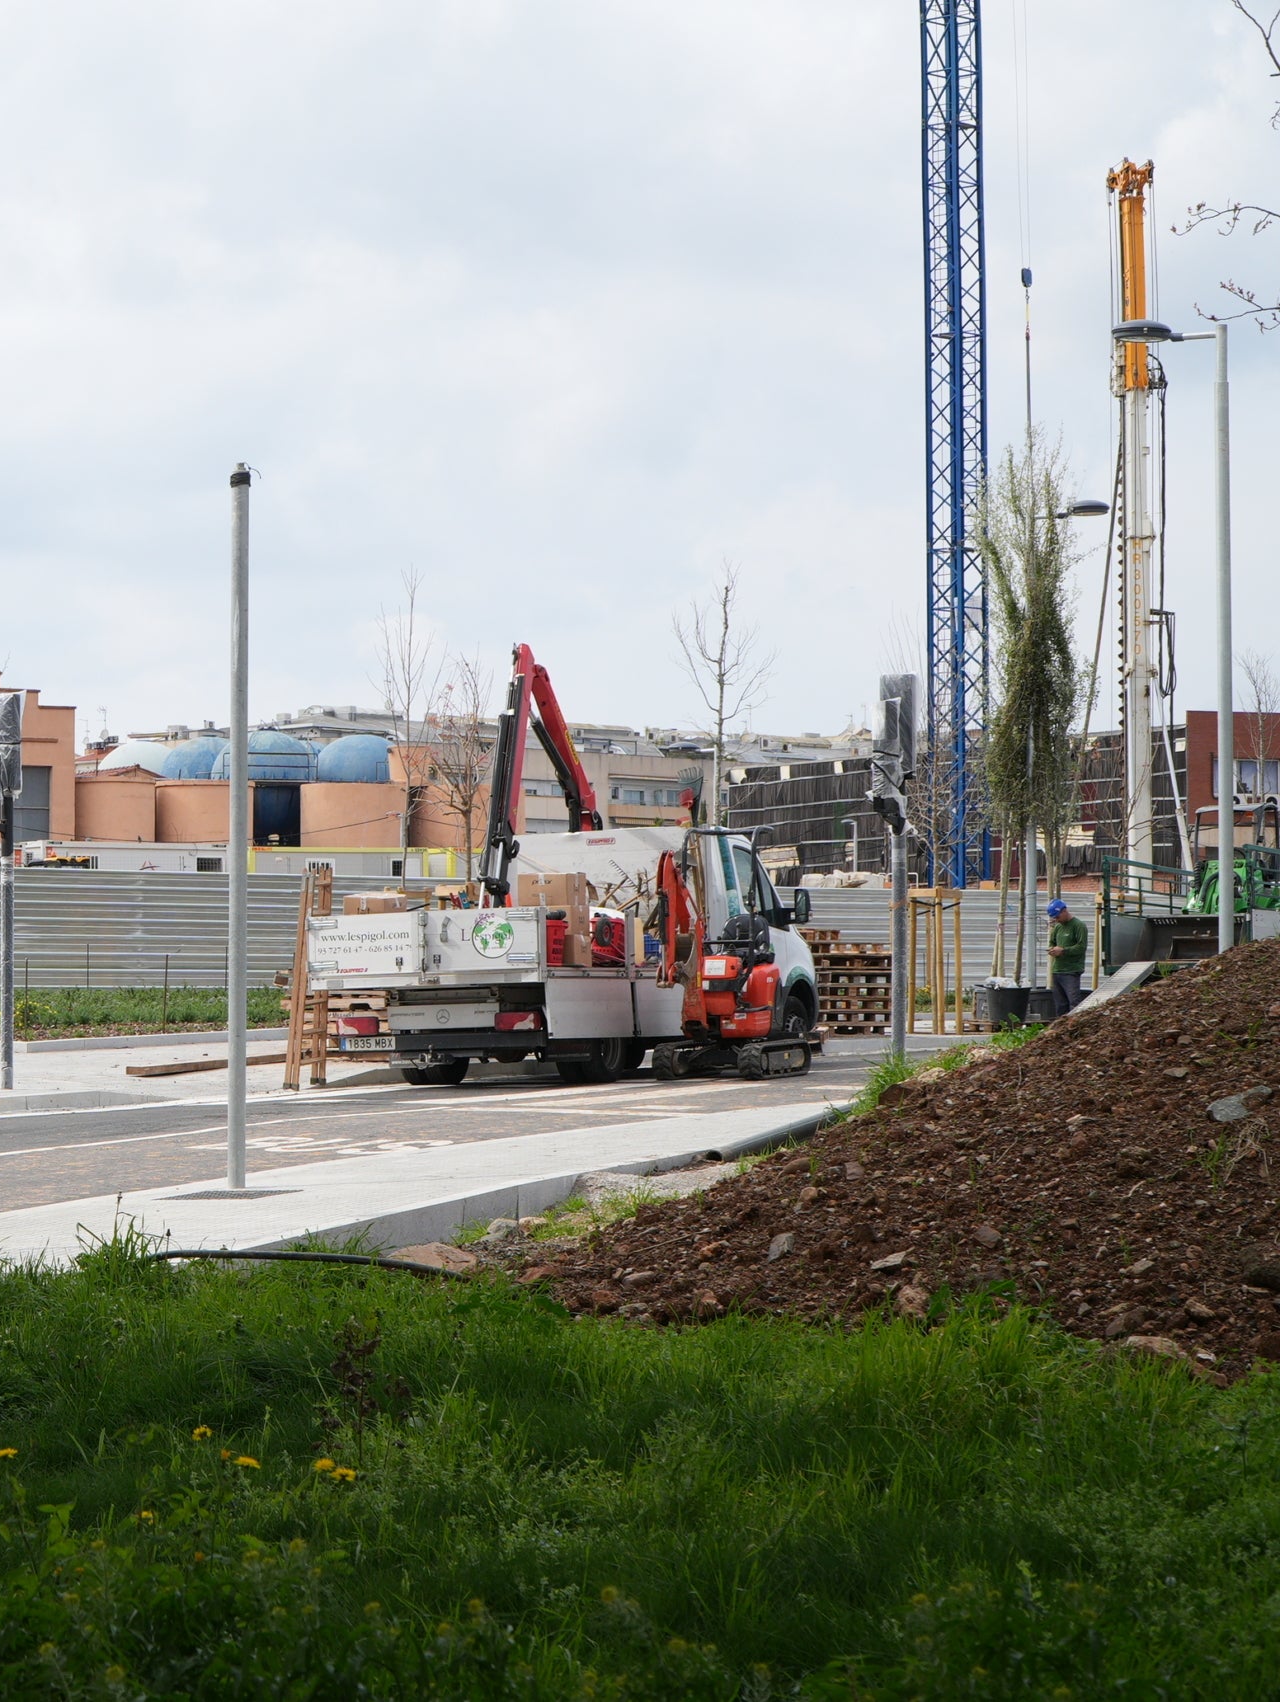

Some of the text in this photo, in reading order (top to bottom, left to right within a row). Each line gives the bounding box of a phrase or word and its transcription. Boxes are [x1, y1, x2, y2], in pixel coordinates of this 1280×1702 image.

[320, 930, 410, 943] www.lespigol.com
[368, 945, 382, 953] 626
[384, 944, 392, 952] 85
[348, 1037, 394, 1050] 1835 MBX
